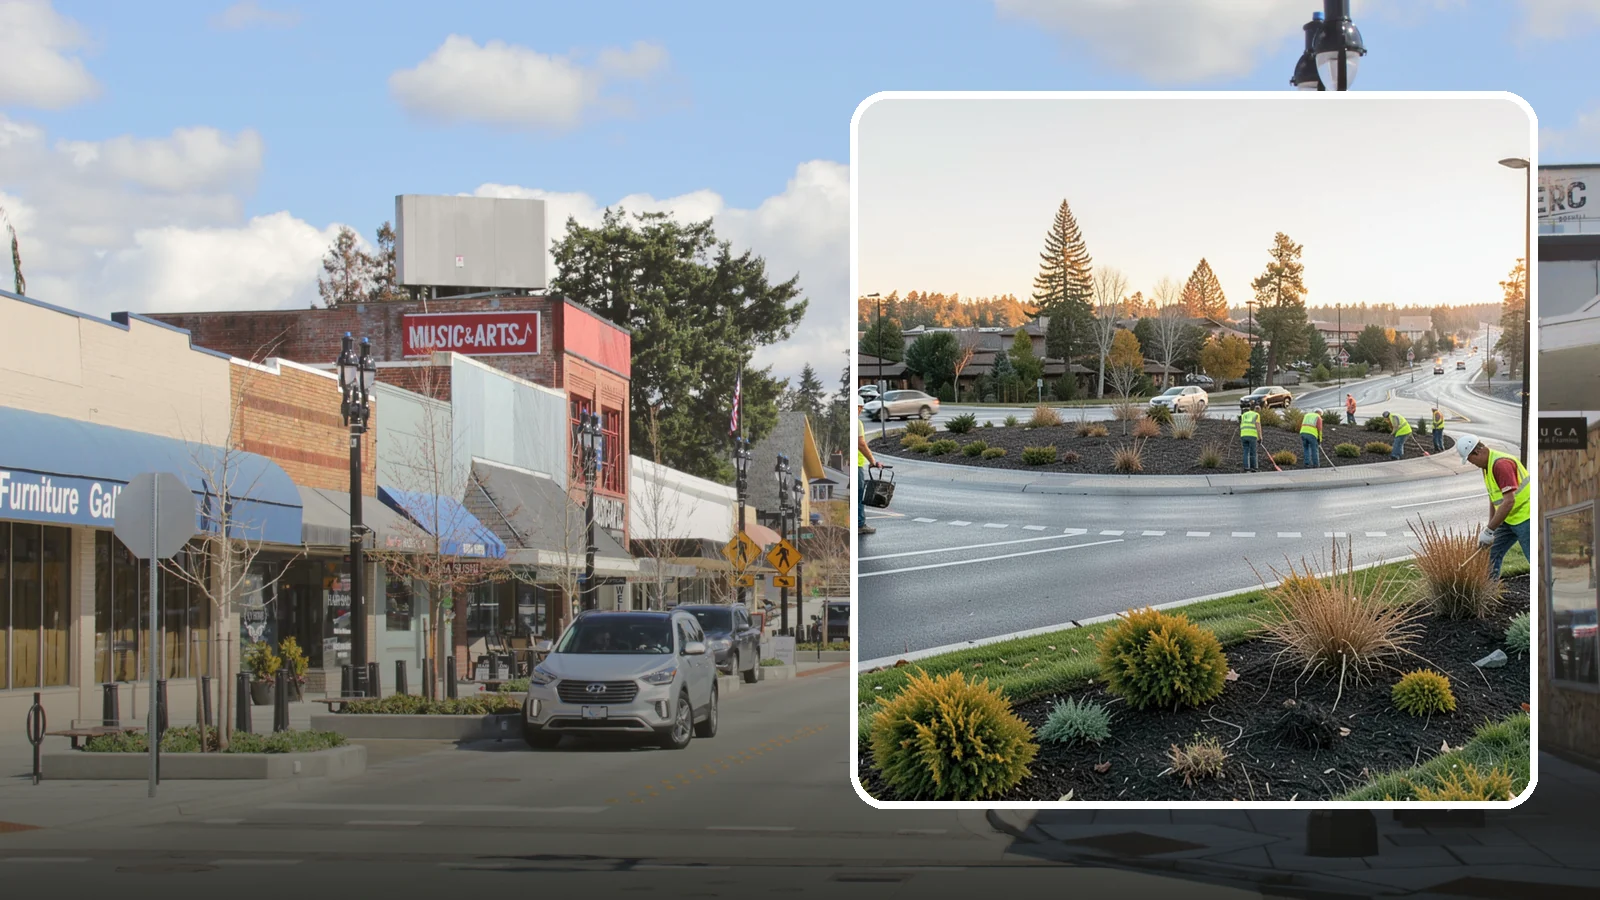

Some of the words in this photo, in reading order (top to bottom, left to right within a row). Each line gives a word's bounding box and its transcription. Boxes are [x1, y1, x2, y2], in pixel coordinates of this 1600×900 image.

[409, 323, 520, 349] MUSIC&ARTS
[0, 471, 79, 516] Furniture
[89, 482, 122, 519] Gal
